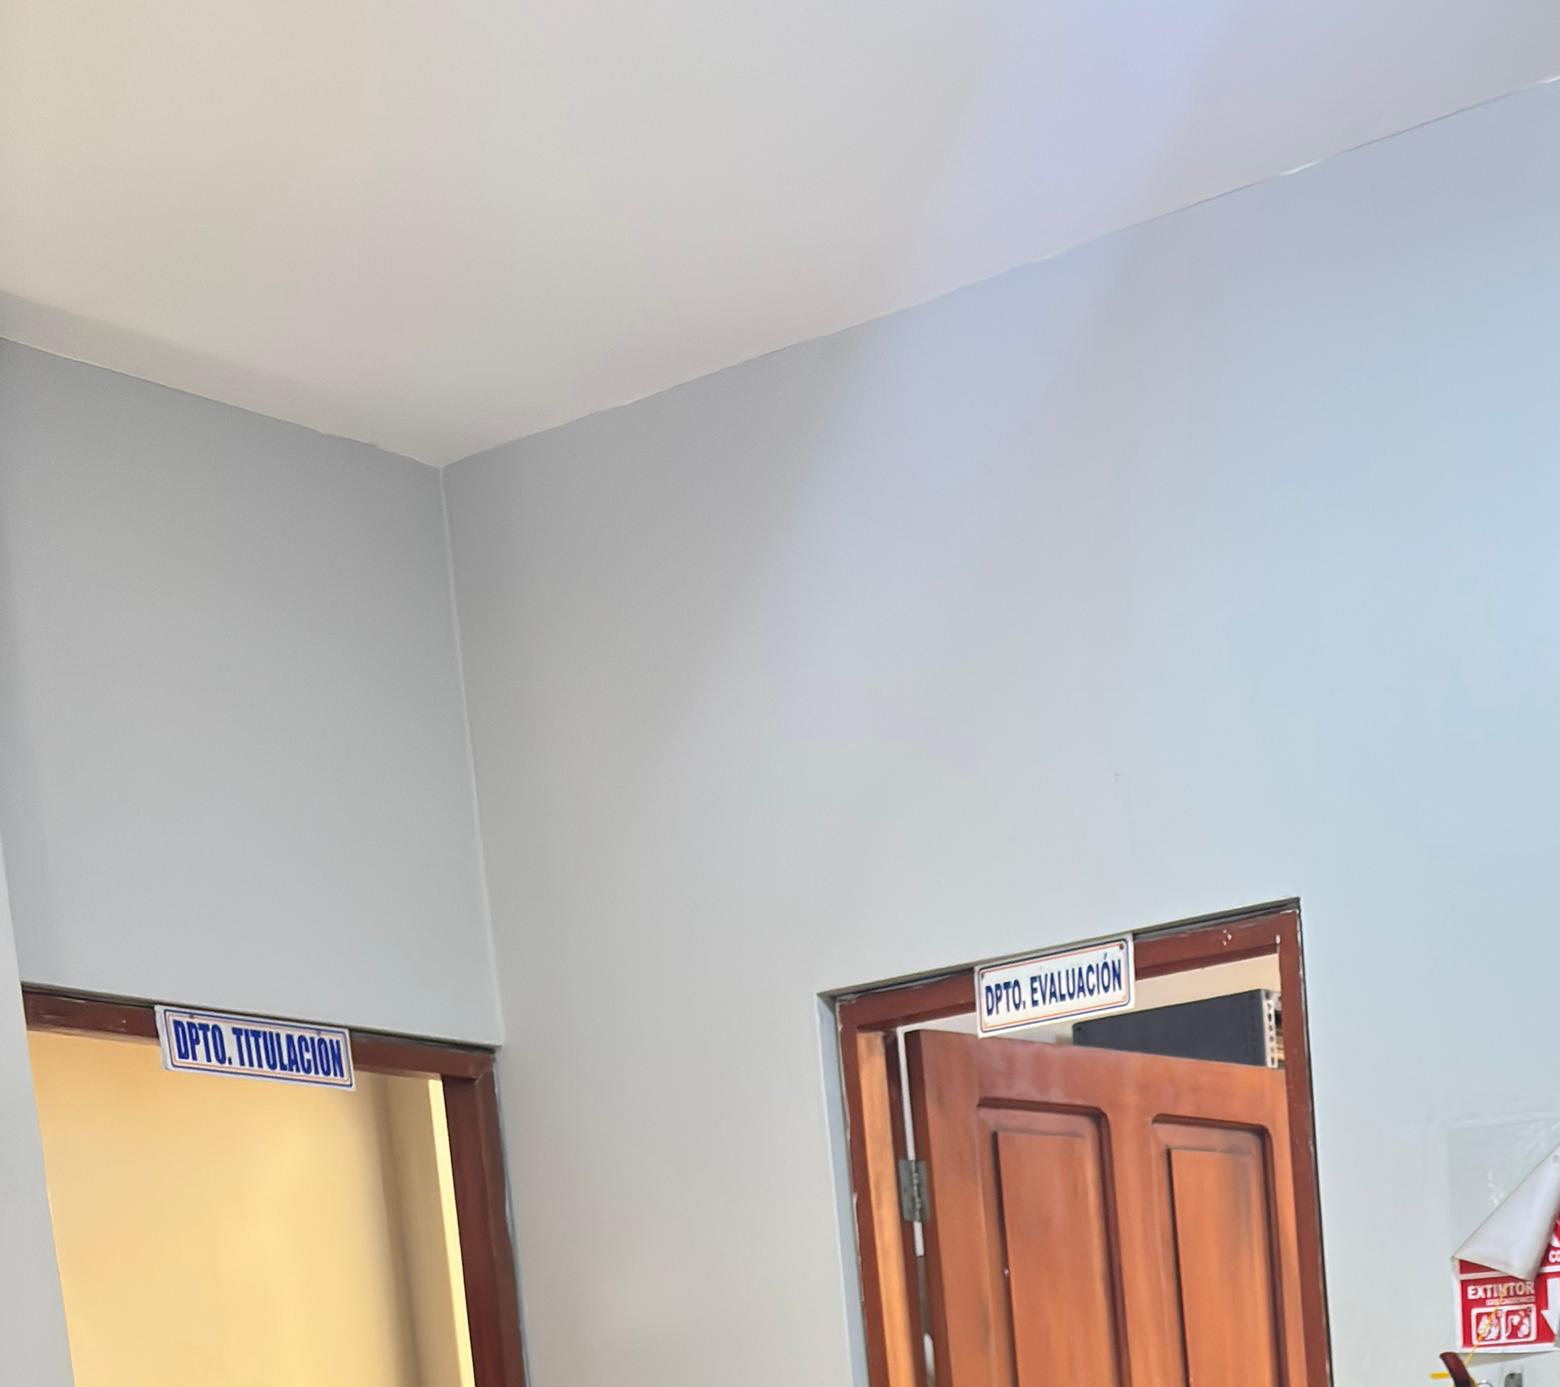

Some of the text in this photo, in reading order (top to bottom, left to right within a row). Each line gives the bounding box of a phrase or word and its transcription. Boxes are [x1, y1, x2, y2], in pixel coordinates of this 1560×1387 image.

[985, 952, 1122, 1016] DPTO. EVALUACIÓN
[172, 1019, 232, 1065] DPTO.
[1467, 1282, 1535, 1299] EXTINTOR
